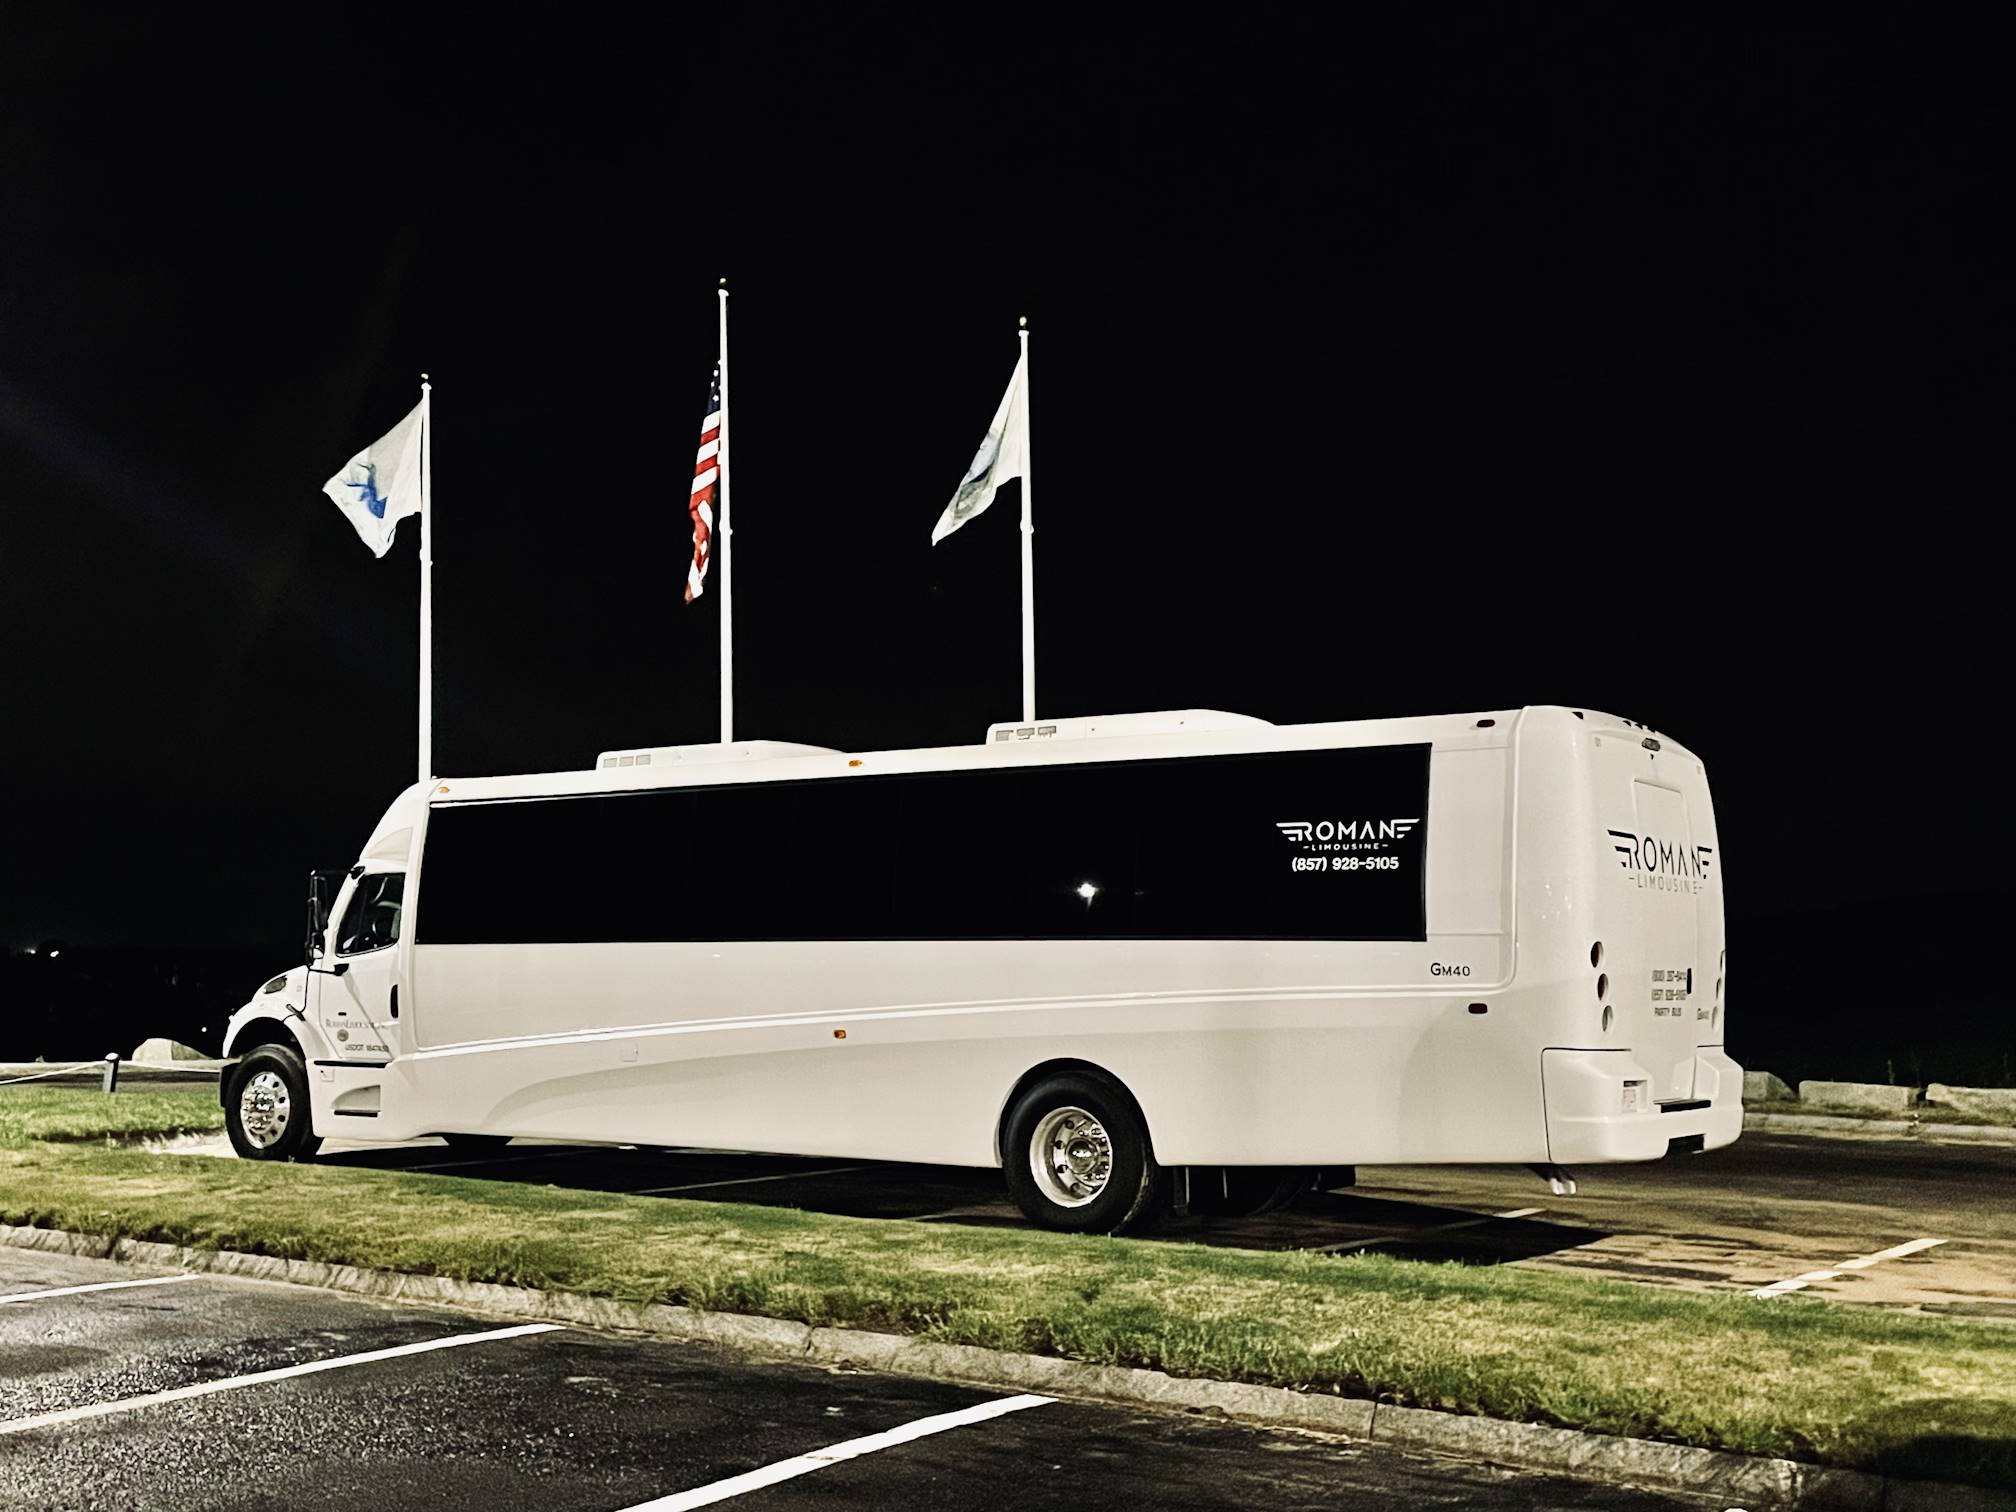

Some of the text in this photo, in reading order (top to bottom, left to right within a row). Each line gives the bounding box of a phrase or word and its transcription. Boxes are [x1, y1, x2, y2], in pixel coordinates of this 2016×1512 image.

[1276, 818, 1420, 842] ROMAN
[1311, 843, 1380, 851] LIMOUSINE
[1607, 829, 1712, 879] ROMAN
[1291, 856, 1400, 872] (857) 928-5105
[1637, 873, 1698, 895] LIMOUSINE
